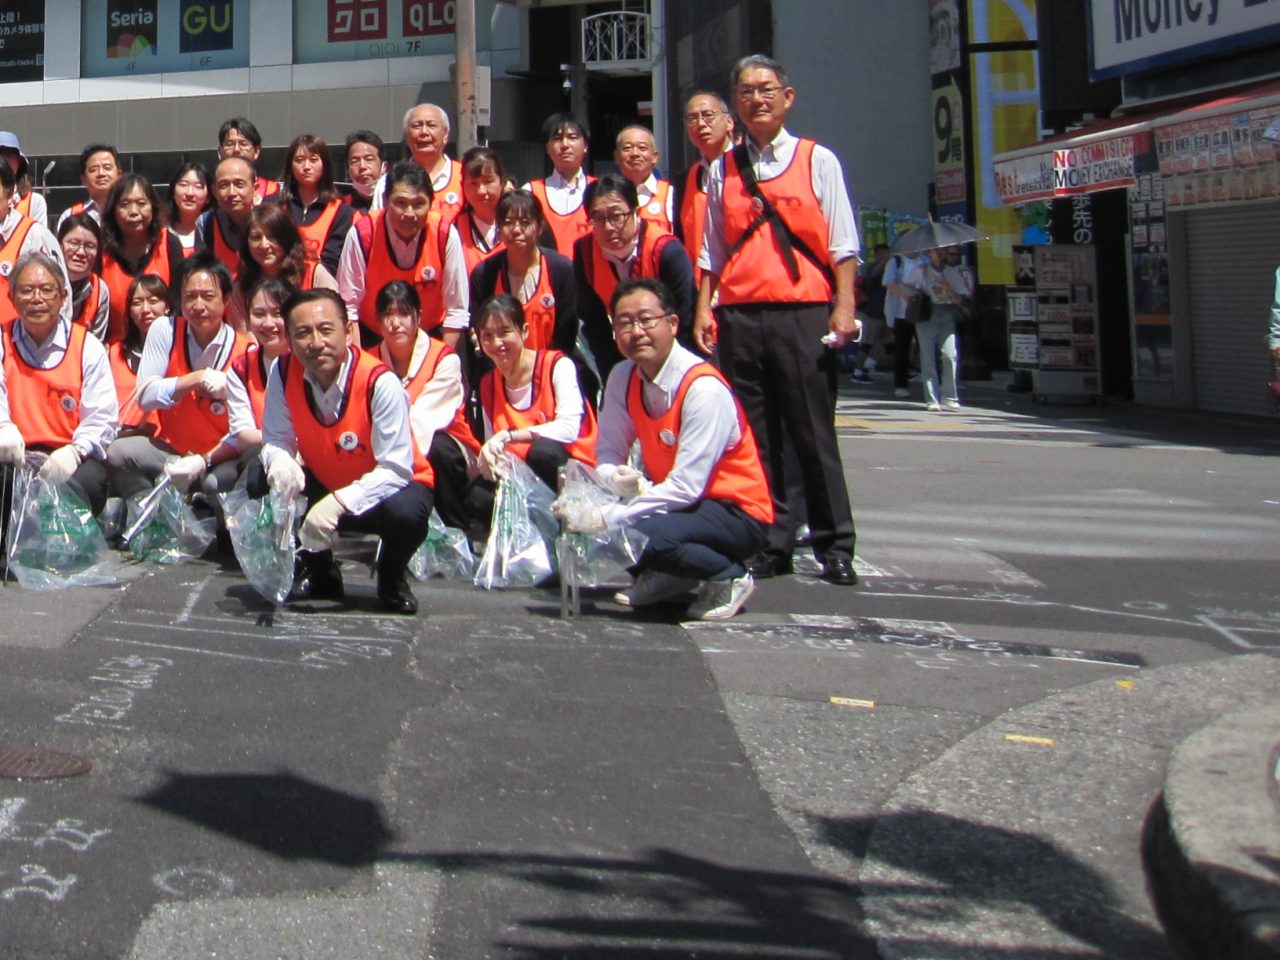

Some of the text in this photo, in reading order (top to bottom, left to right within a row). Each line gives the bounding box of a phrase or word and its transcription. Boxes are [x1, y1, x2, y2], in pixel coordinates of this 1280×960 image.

[110, 8, 154, 28] Seria
[183, 4, 232, 35] GU
[406, 41, 421, 53] 7F
[1053, 149, 1077, 169] NO
